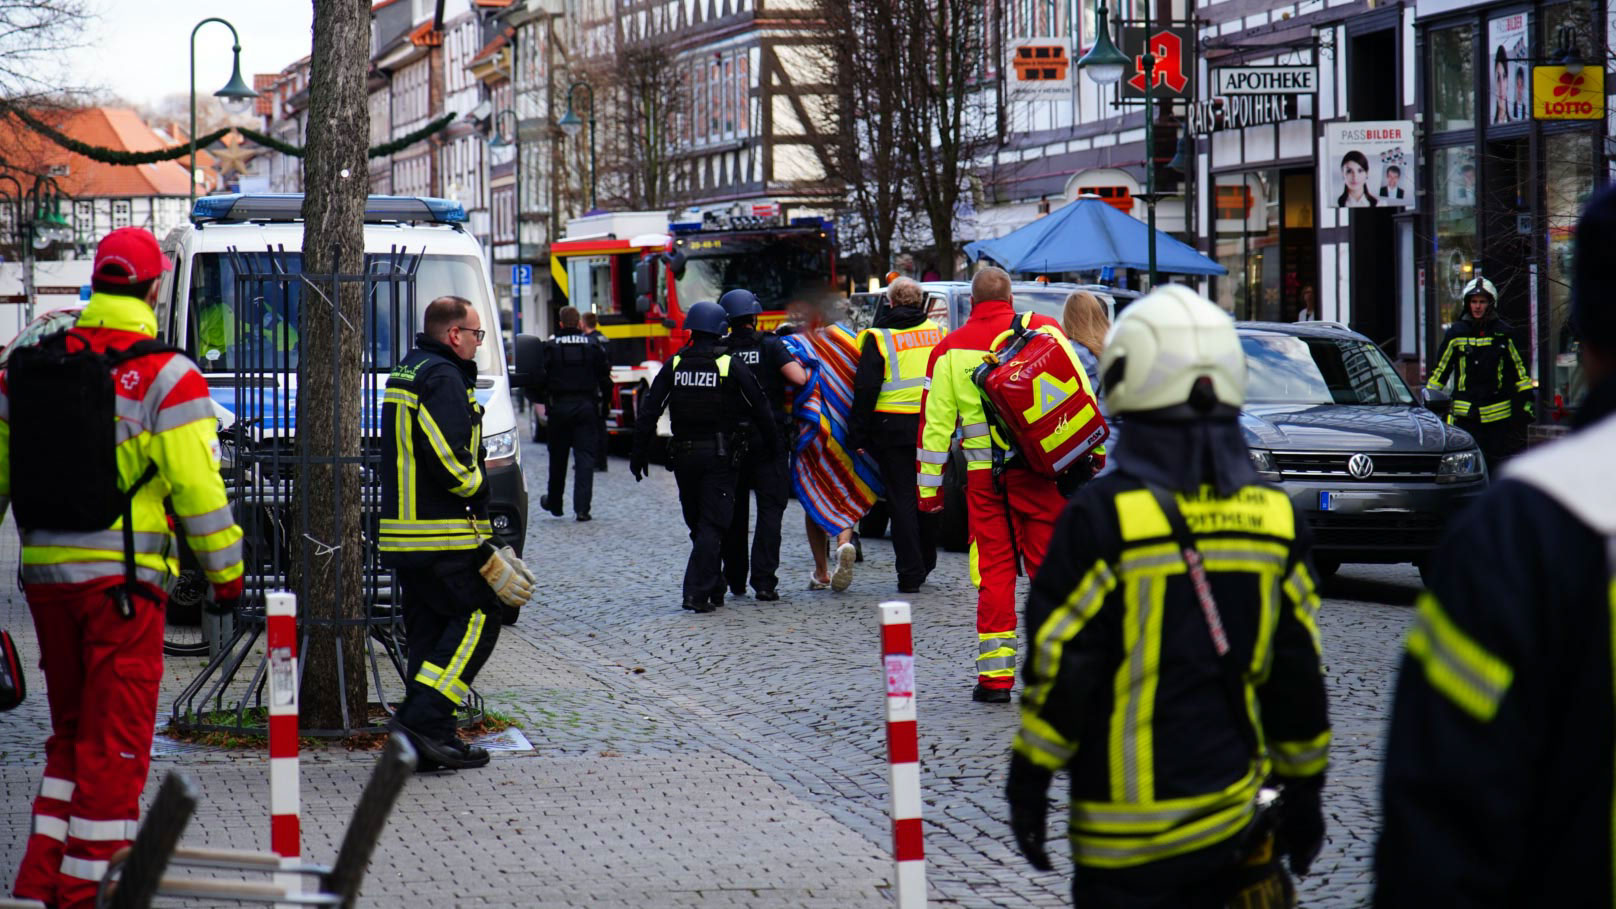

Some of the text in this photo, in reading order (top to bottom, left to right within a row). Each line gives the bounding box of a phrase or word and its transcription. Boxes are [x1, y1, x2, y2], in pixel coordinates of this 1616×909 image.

[1226, 72, 1311, 89] APOTHEKE
[1544, 101, 1592, 114] LOTTO
[1341, 129, 1402, 140] PASSBILDER
[556, 335, 588, 344] POLIZEI
[895, 329, 941, 350] POLIZEI
[674, 371, 717, 387] POLIZEI
